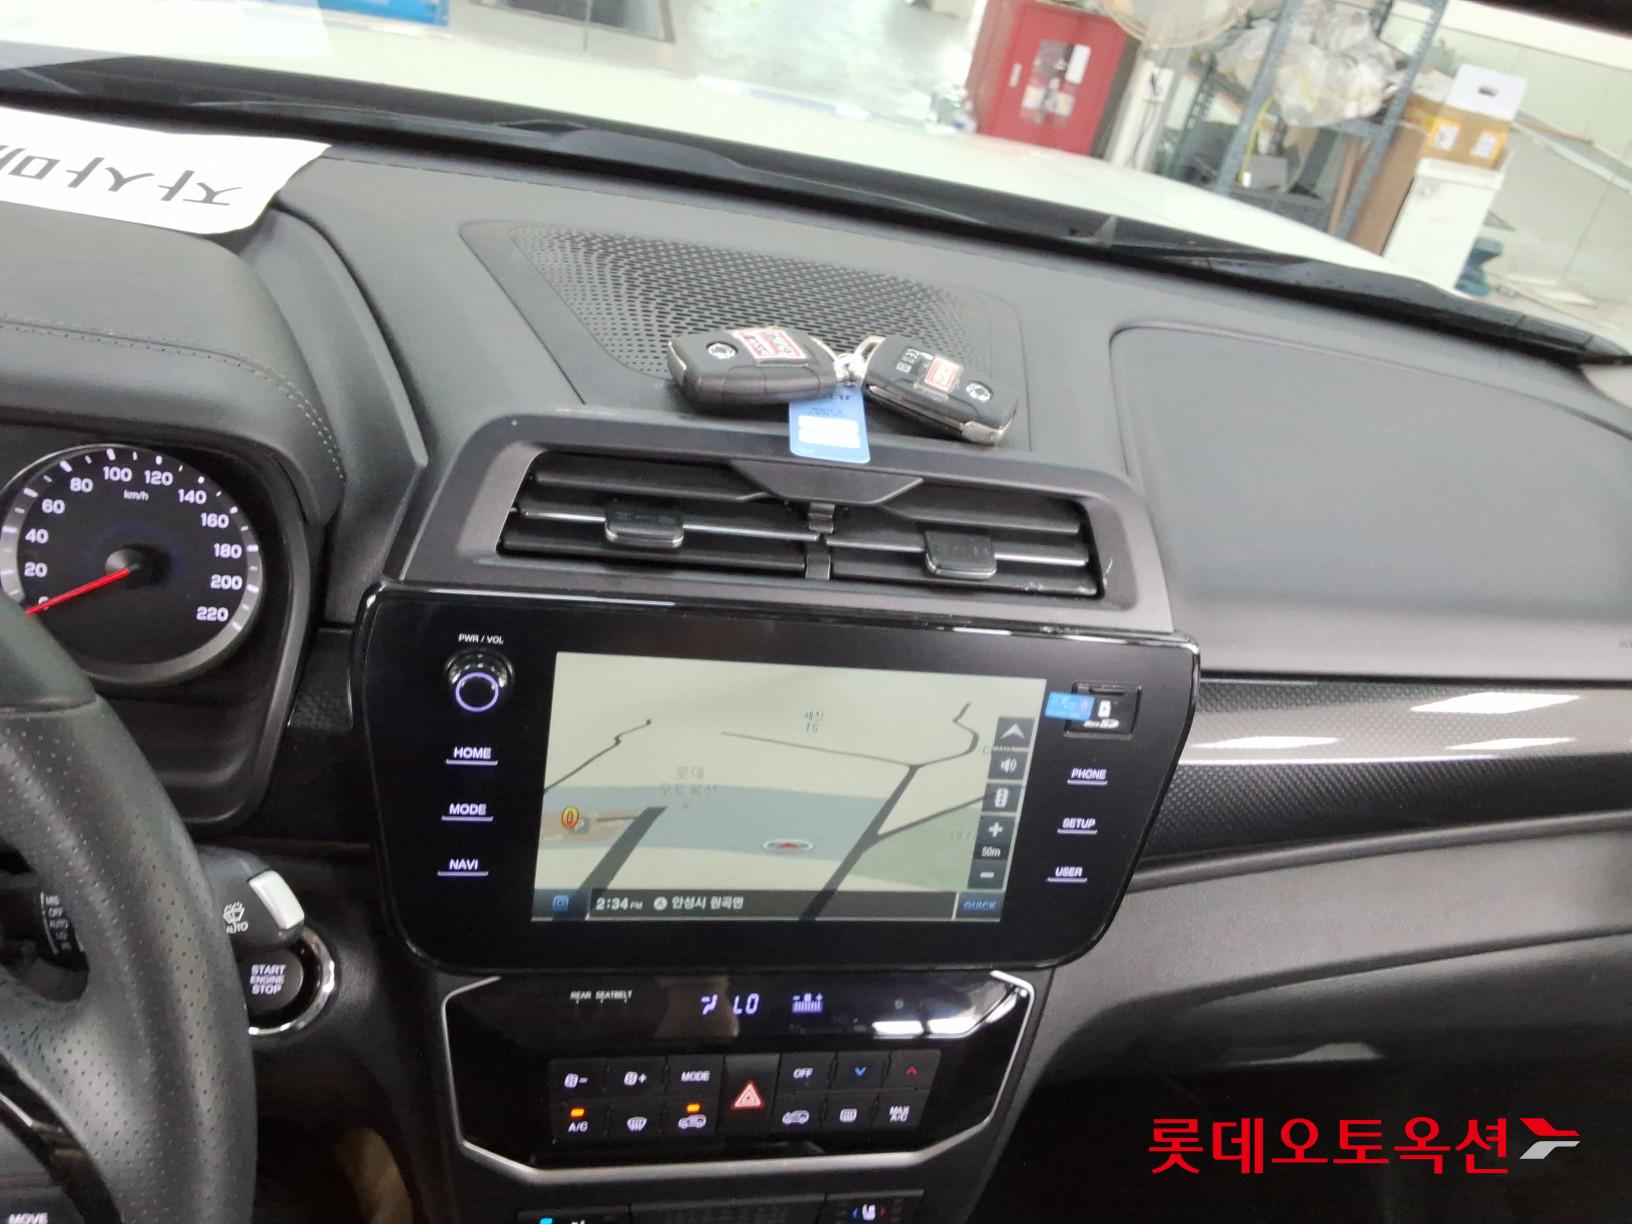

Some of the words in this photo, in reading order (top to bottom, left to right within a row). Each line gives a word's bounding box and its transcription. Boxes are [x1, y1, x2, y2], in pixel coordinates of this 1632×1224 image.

[103, 466, 133, 482] 100
[144, 470, 174, 486] 120
[69, 477, 94, 493] 80
[123, 489, 149, 501] km/h
[178, 488, 207, 505] 140
[41, 498, 66, 515] 60
[200, 511, 229, 529] 160
[25, 528, 49, 544] 40
[213, 543, 243, 559] 180
[24, 561, 48, 578] 20
[210, 574, 244, 592] 200
[196, 606, 229, 623] 220
[458, 633, 479, 643] PWR
[487, 635, 504, 645] VOL
[453, 746, 492, 760] HOME
[1070, 767, 1107, 781] PHONE
[449, 803, 487, 817] MODE
[1062, 817, 1096, 830] SETUP
[449, 858, 479, 871] NAVI
[1055, 866, 1083, 878] USER
[595, 897, 629, 911] 2:34
[671, 895, 707, 910] 안성시
[963, 900, 997, 910] QUICK
[250, 964, 286, 977] START
[249, 975, 285, 985] ENGINE
[251, 984, 283, 995] STOP
[732, 993, 760, 1015] LO
[680, 1070, 710, 1083] MODE
[793, 1067, 813, 1079] OFF
[567, 1121, 589, 1133] A/C
